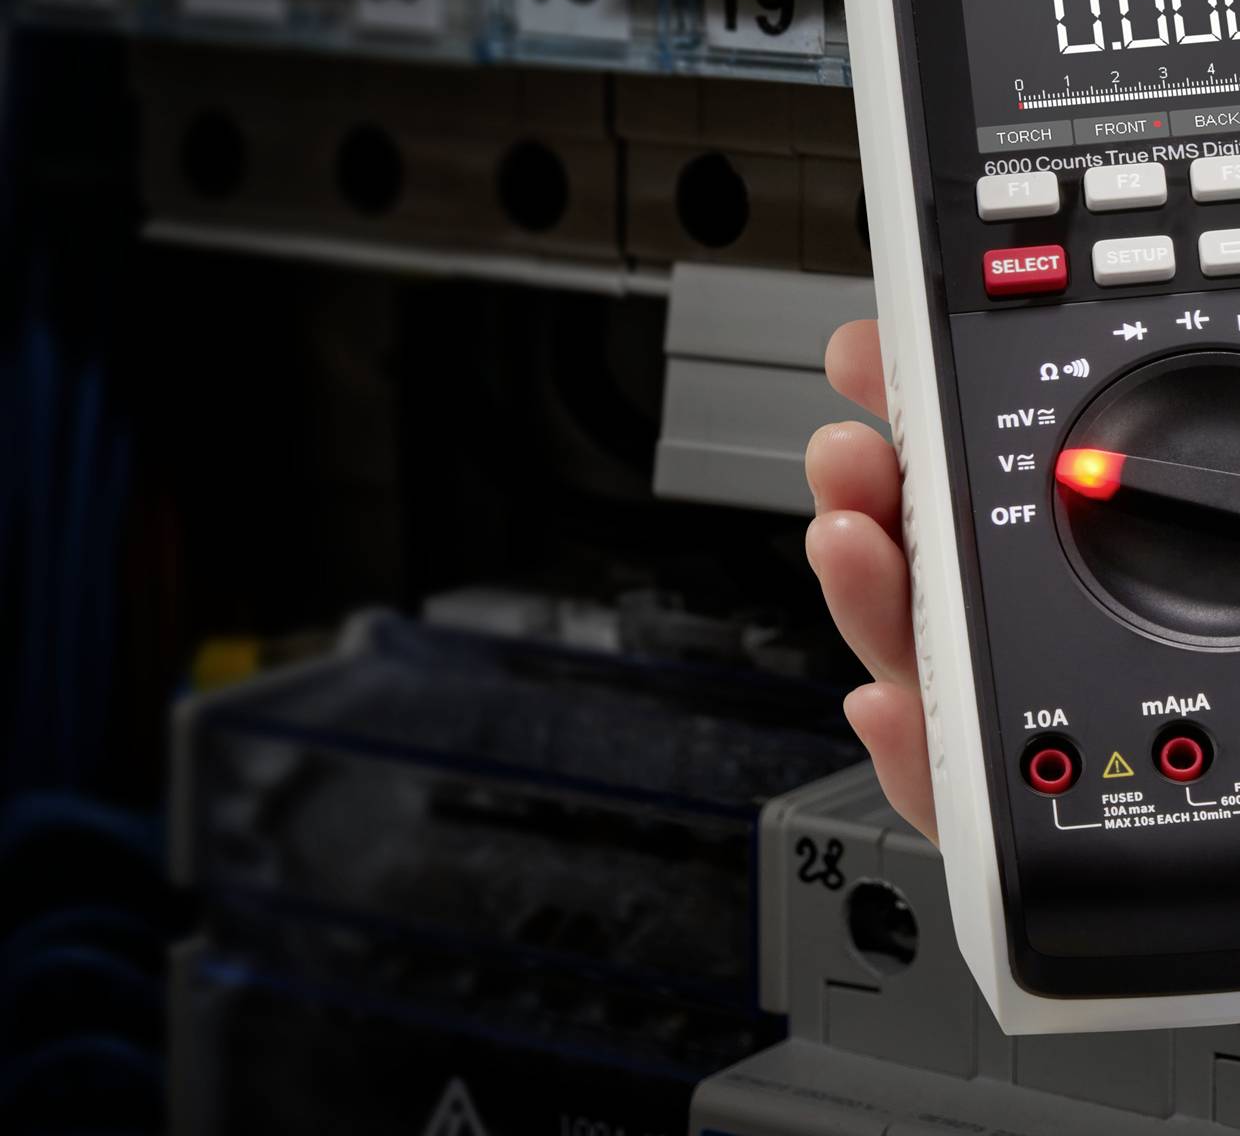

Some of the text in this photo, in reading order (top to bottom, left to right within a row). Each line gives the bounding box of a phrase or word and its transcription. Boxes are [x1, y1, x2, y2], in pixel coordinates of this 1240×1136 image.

[1014, 78, 1024, 92] 0
[1063, 74, 1071, 87] 1
[1111, 70, 1121, 83] 2
[1159, 66, 1168, 79] 3
[1207, 62, 1216, 75] 4
[1094, 120, 1147, 136] FRONT
[1194, 111, 1240, 127] BACK
[996, 128, 1053, 144] TORCH
[984, 157, 1032, 176] 6000
[1036, 151, 1103, 172] Counts
[1105, 148, 1150, 166] True
[1153, 143, 1200, 162] RMS
[1006, 181, 1031, 198] F1
[1116, 173, 1142, 189] F2
[991, 255, 1061, 275] SELECT
[1106, 246, 1168, 265] SETUP
[1040, 362, 1059, 381] Ω
[991, 504, 1037, 525] OFF
[1141, 692, 1212, 717] mAµA
[1023, 708, 1069, 730] 10A
[1102, 791, 1144, 805] FUSED
[1103, 804, 1156, 818] 10A max
[1104, 808, 1233, 830] MAX 10s EACH 10min
[795, 836, 846, 891] 28
